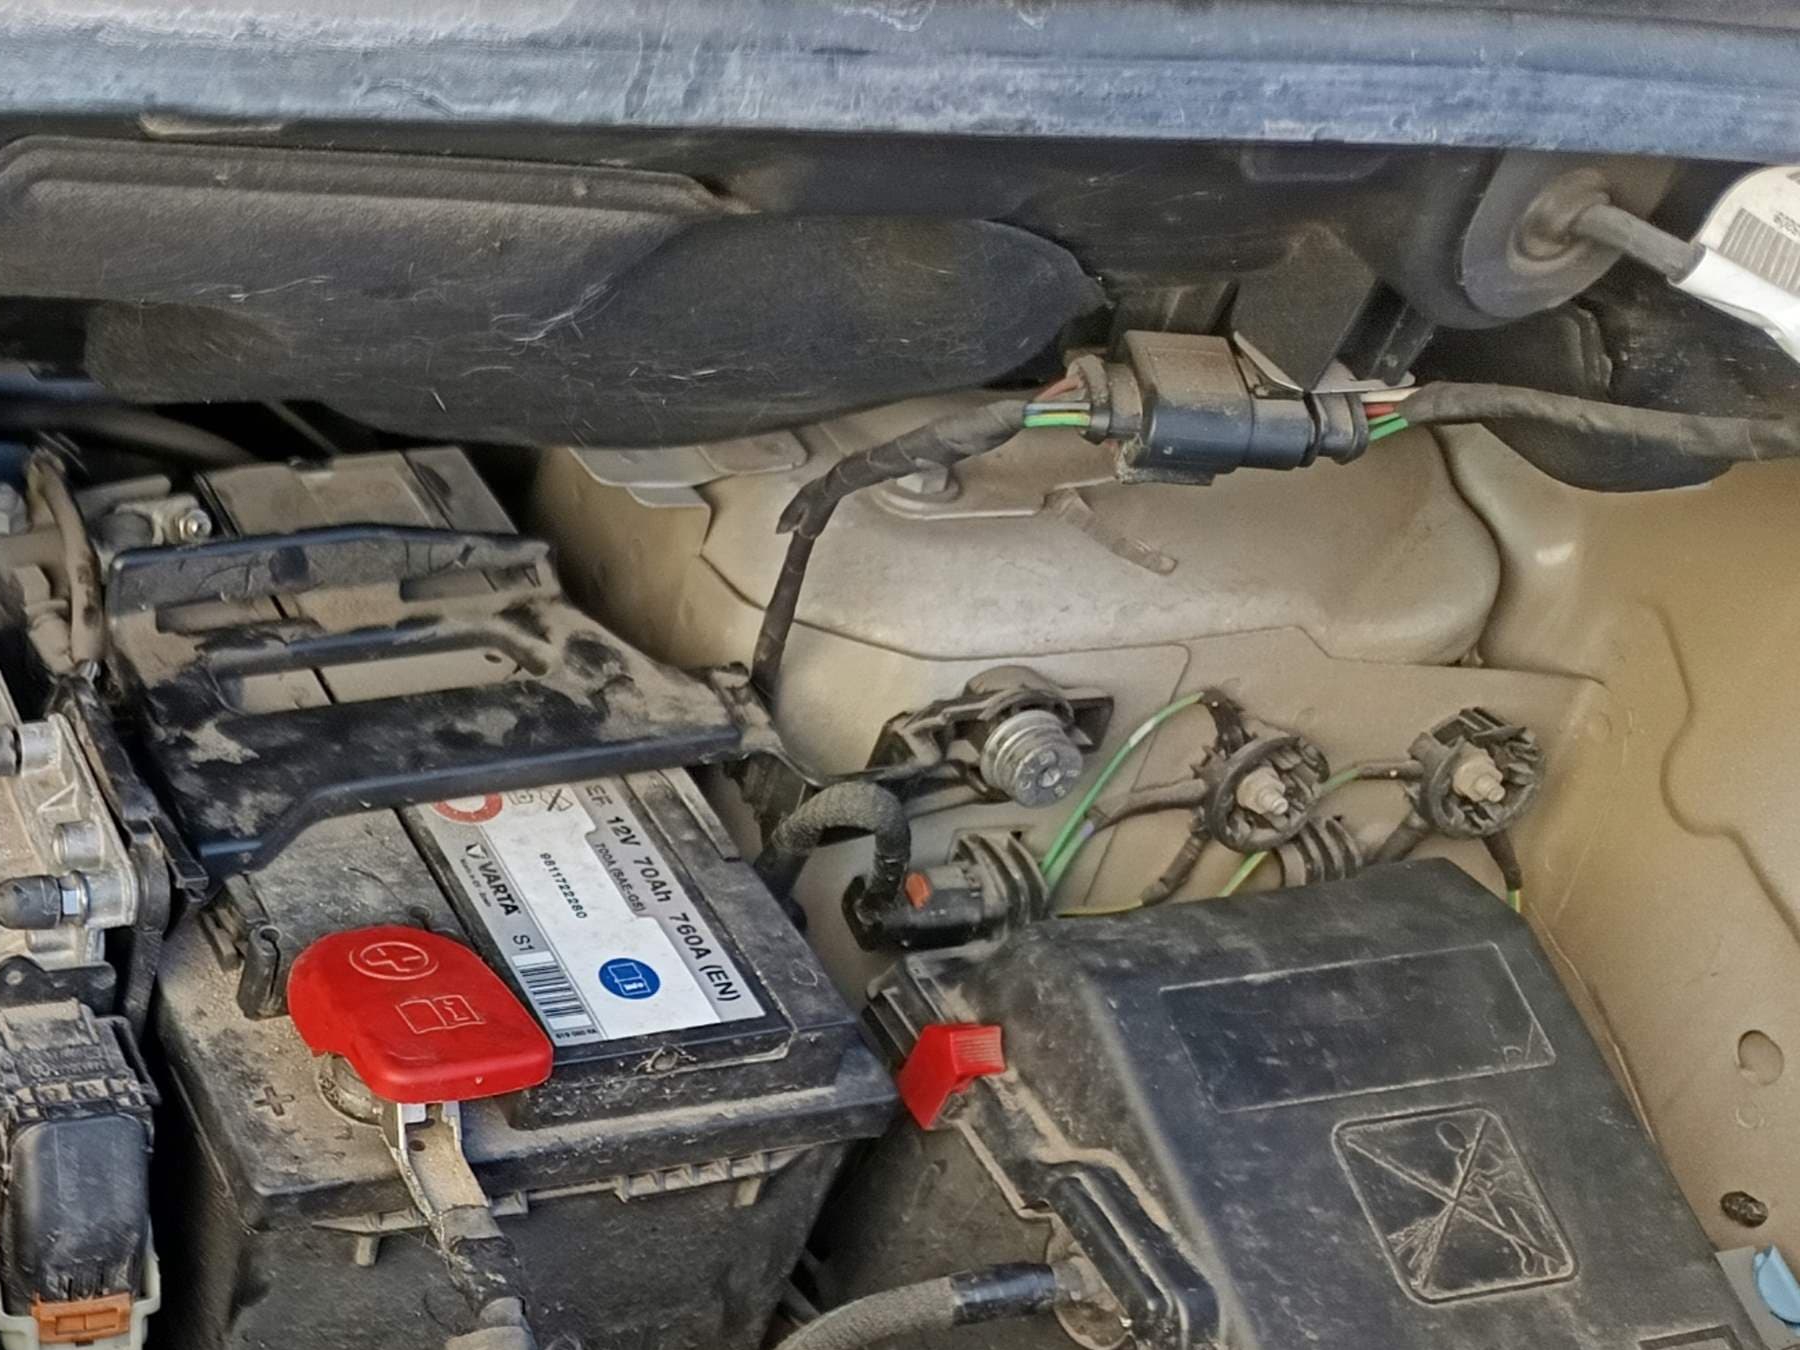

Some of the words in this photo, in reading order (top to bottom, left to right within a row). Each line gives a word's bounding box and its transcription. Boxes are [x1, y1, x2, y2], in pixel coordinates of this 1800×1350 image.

[479, 861, 519, 916] VARTA
[606, 816, 641, 846] 12V
[633, 857, 672, 902] 70Ah
[669, 912, 712, 960] 760A
[699, 964, 741, 1002] (EN)
[512, 934, 535, 951] S1
